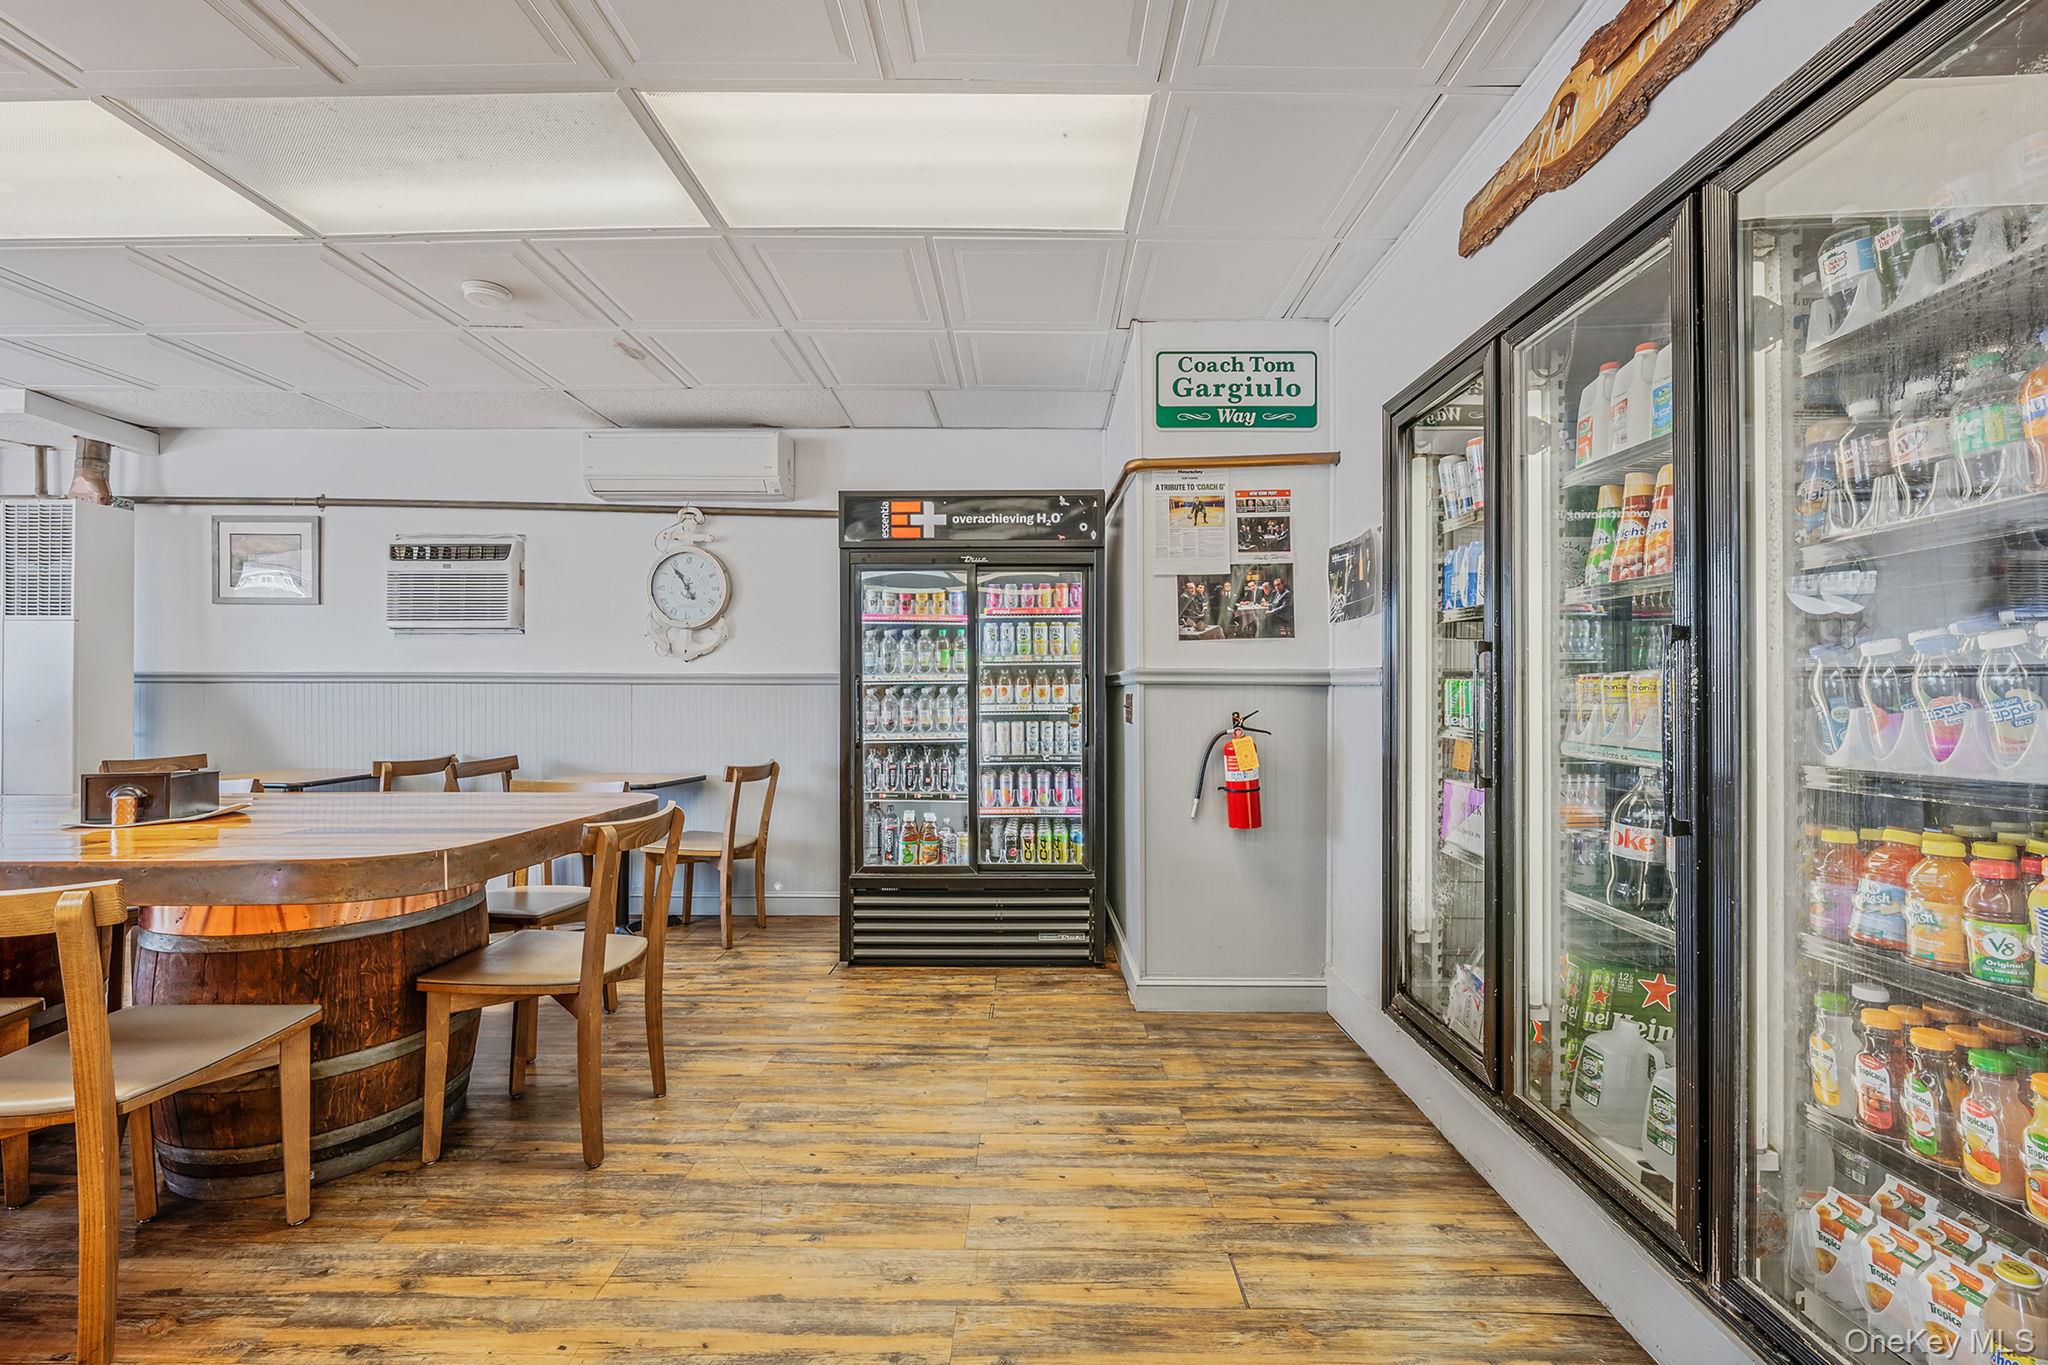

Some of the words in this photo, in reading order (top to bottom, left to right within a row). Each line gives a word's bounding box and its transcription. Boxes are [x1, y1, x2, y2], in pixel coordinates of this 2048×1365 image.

[1178, 356, 1245, 373] Coach
[1249, 356, 1296, 373] Tom
[1172, 376, 1301, 404] Gargiulo
[1217, 408, 1257, 427] Way
[881, 501, 890, 539] essentia
[952, 513, 1035, 526] overachieving
[961, 555, 989, 563] True
[1988, 937, 2015, 956] V8
[1985, 959, 2024, 969] Original
